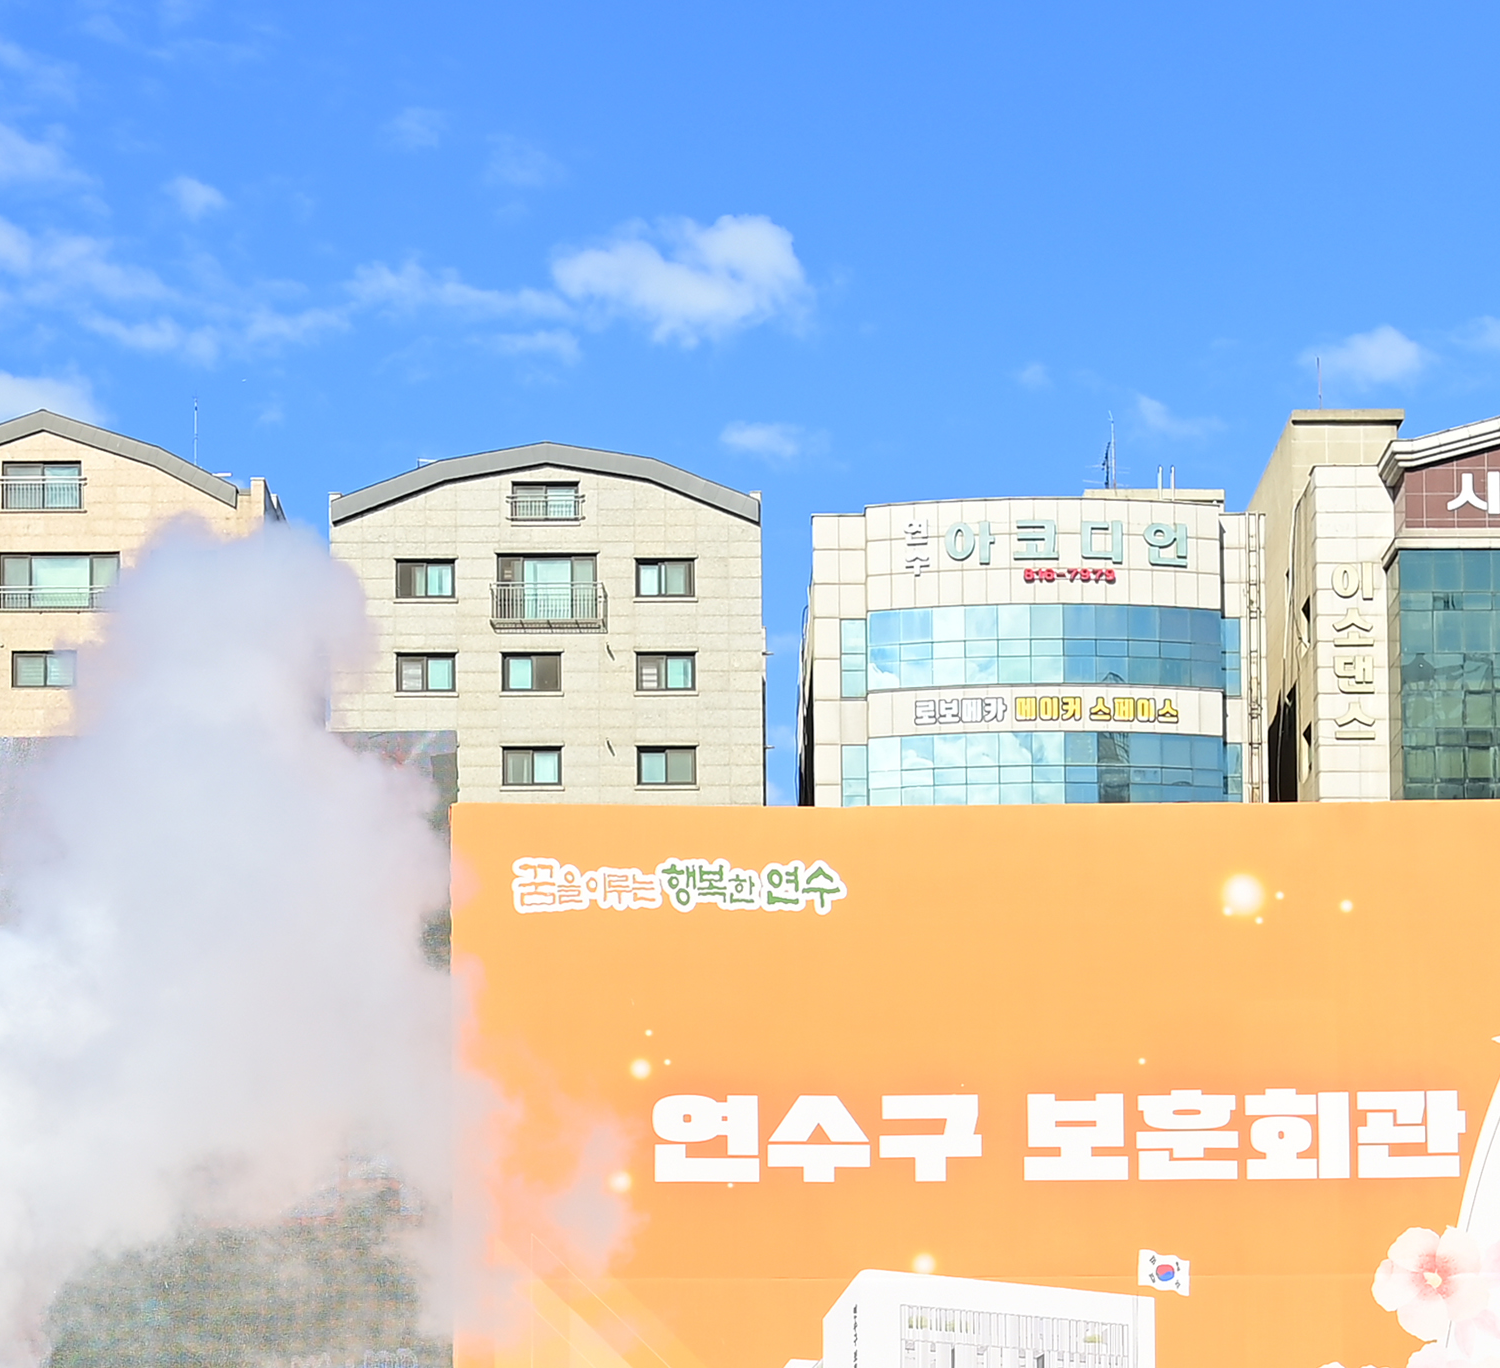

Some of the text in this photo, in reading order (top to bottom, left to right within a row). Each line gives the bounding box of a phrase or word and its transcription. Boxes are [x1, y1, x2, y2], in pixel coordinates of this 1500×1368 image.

[904, 518, 1188, 577] 연수 아코디언
[1331, 562, 1376, 741] 이소댄스
[914, 696, 1179, 725] 로보메카 메이커 스페이스
[662, 863, 755, 906] 행복한
[766, 866, 840, 909] 연수
[651, 1093, 983, 1183] 연수구
[1024, 1088, 1465, 1182] 보훈회관
